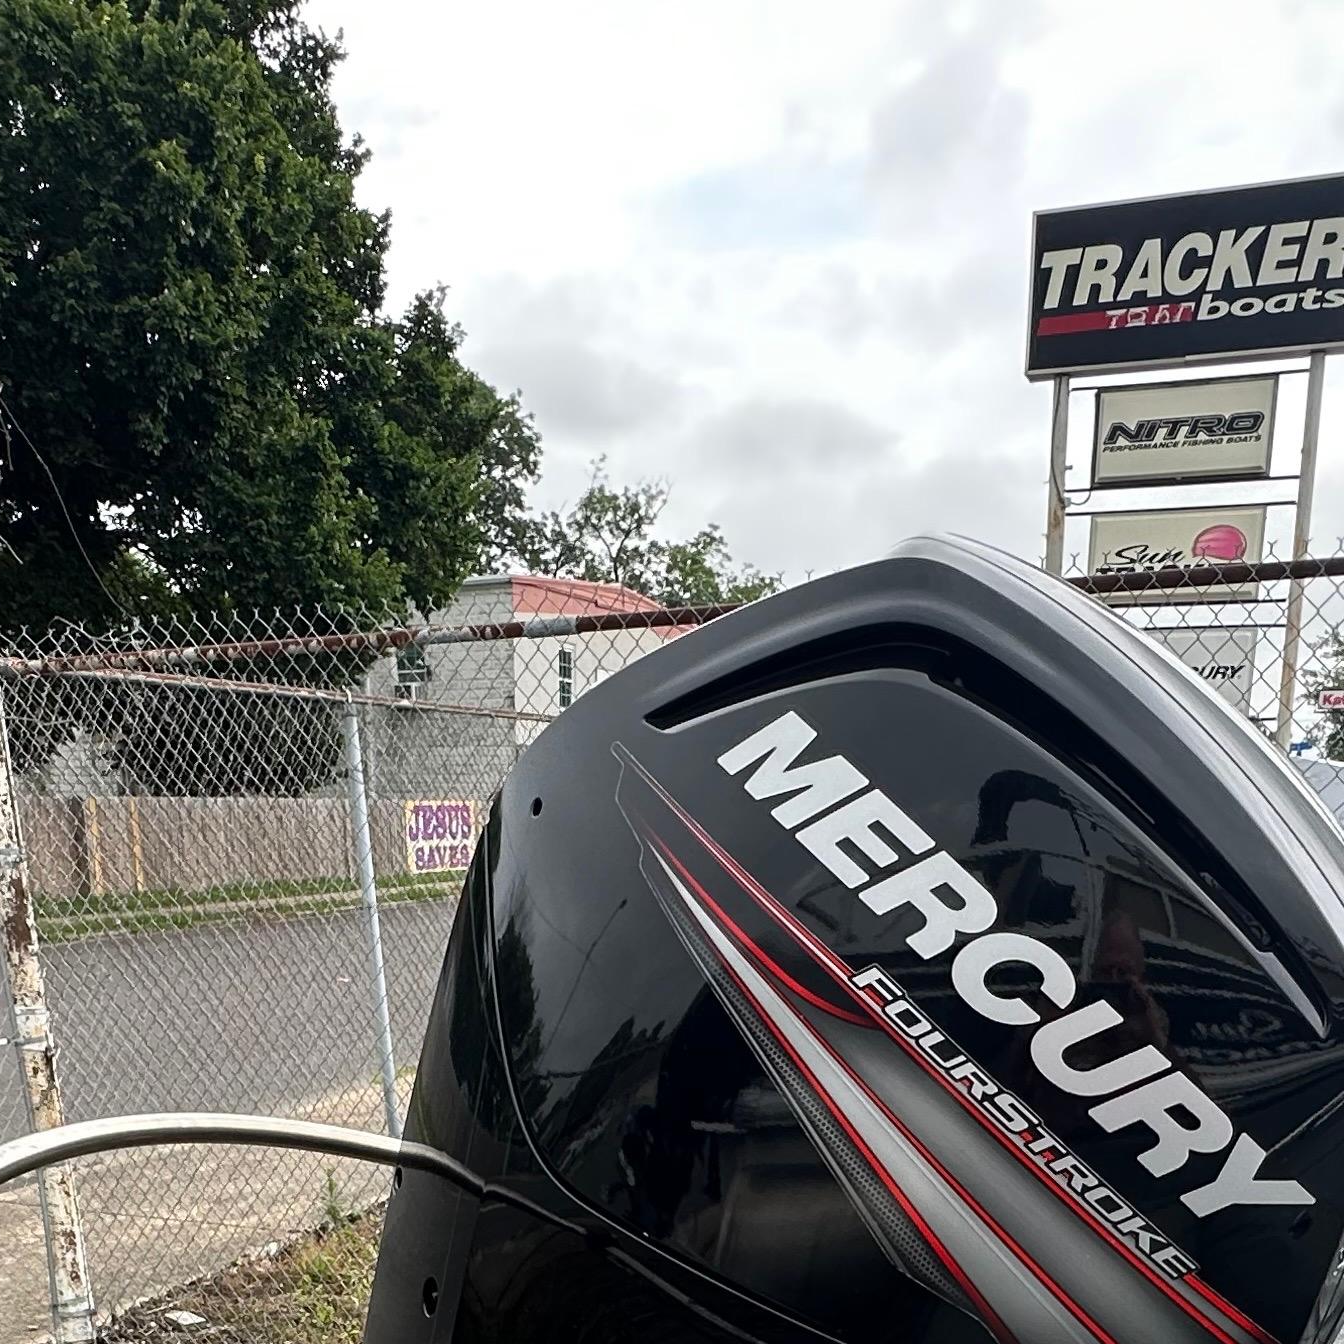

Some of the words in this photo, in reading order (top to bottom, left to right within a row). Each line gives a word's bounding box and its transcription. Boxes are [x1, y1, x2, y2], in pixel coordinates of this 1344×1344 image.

[1103, 441, 1179, 452] PERFORMANCE
[1182, 437, 1223, 447] FISHING
[1226, 434, 1262, 444] BOATS
[1104, 411, 1265, 445] NITRO
[1106, 545, 1185, 565] Sun
[409, 805, 471, 841] JESUS
[415, 844, 470, 870] SAVES
[716, 710, 1316, 1218] MERCURY
[850, 965, 1196, 1277] FOURSTROKE
